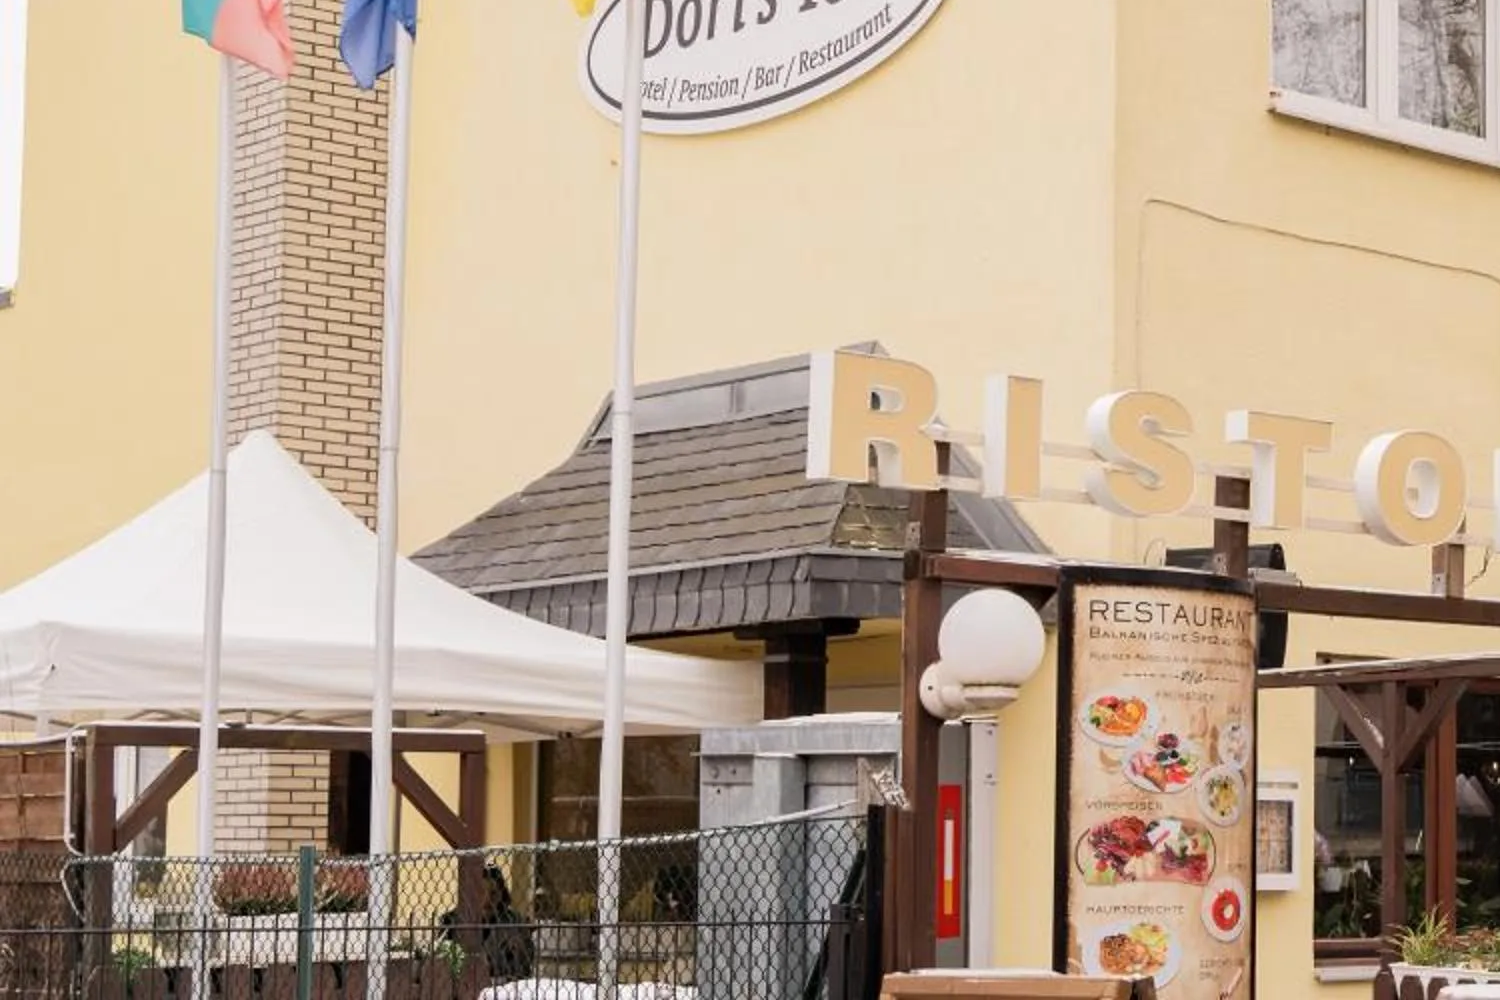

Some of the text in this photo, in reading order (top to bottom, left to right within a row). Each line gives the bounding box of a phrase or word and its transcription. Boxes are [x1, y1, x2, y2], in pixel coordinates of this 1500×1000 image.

[641, 77, 669, 102] otel
[678, 73, 740, 103] Pension
[755, 63, 784, 91] Bar
[798, 2, 894, 76] Restaurant
